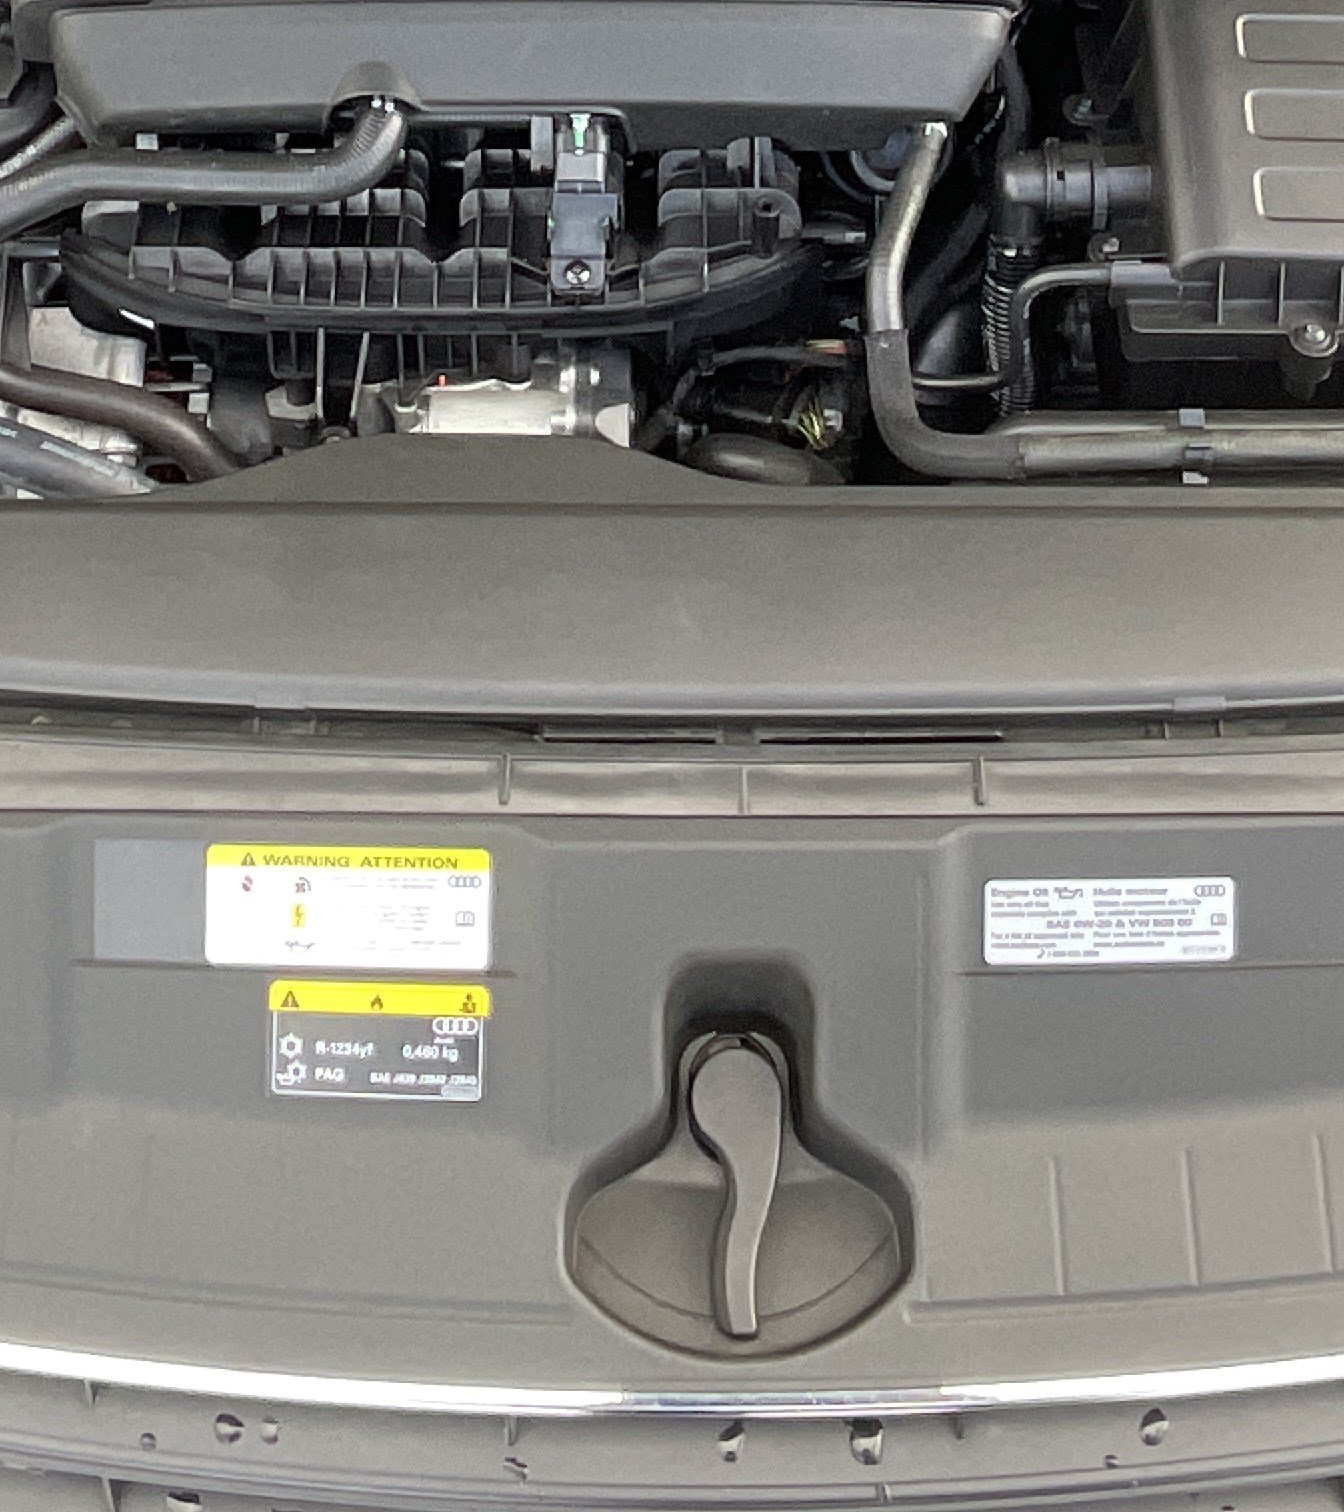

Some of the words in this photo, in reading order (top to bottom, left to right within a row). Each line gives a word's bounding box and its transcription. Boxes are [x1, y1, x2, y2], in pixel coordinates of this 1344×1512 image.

[262, 855, 350, 868] WARNING
[360, 856, 459, 870] ATTENTION
[442, 1045, 460, 1063] kg
[314, 1066, 345, 1082] PAG
